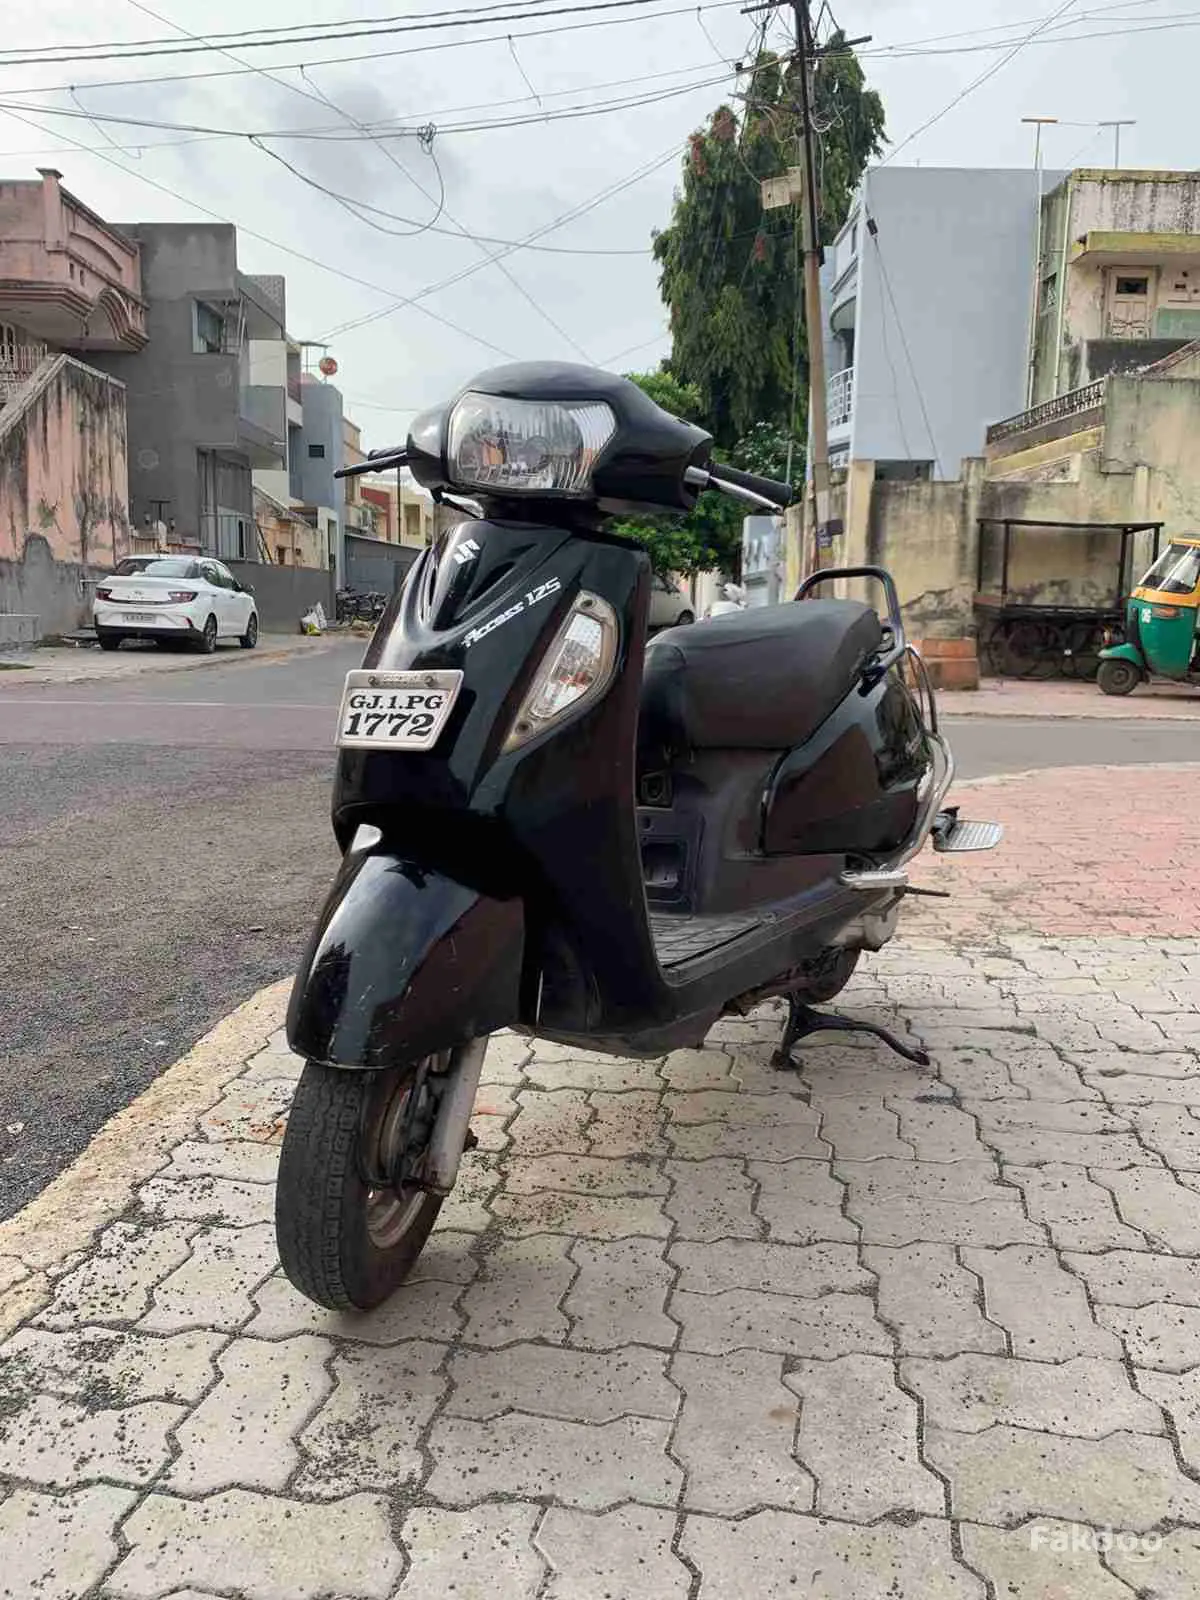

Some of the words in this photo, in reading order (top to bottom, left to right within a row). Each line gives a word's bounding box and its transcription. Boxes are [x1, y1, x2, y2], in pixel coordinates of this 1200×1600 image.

[461, 601, 525, 648] Access
[524, 576, 562, 606] 125
[349, 695, 444, 710] GJ.1.PG
[344, 712, 435, 736] 1772
